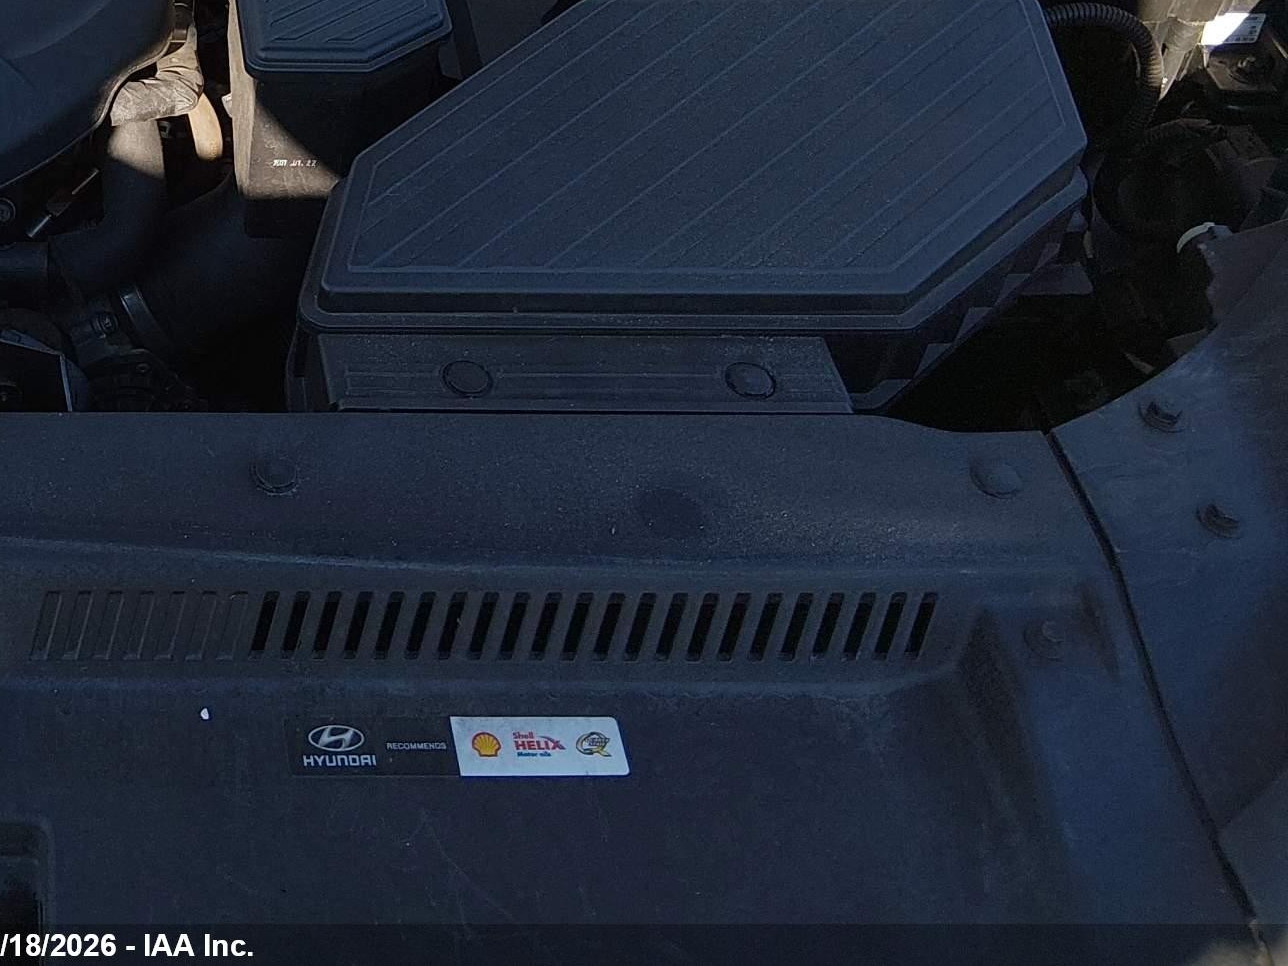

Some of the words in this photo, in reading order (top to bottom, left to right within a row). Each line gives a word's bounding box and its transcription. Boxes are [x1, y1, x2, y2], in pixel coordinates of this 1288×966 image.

[512, 732, 534, 740] Shell
[514, 740, 566, 751] HELIX
[303, 754, 377, 767] HYUNDAI
[386, 742, 447, 750] RECOMMENDS
